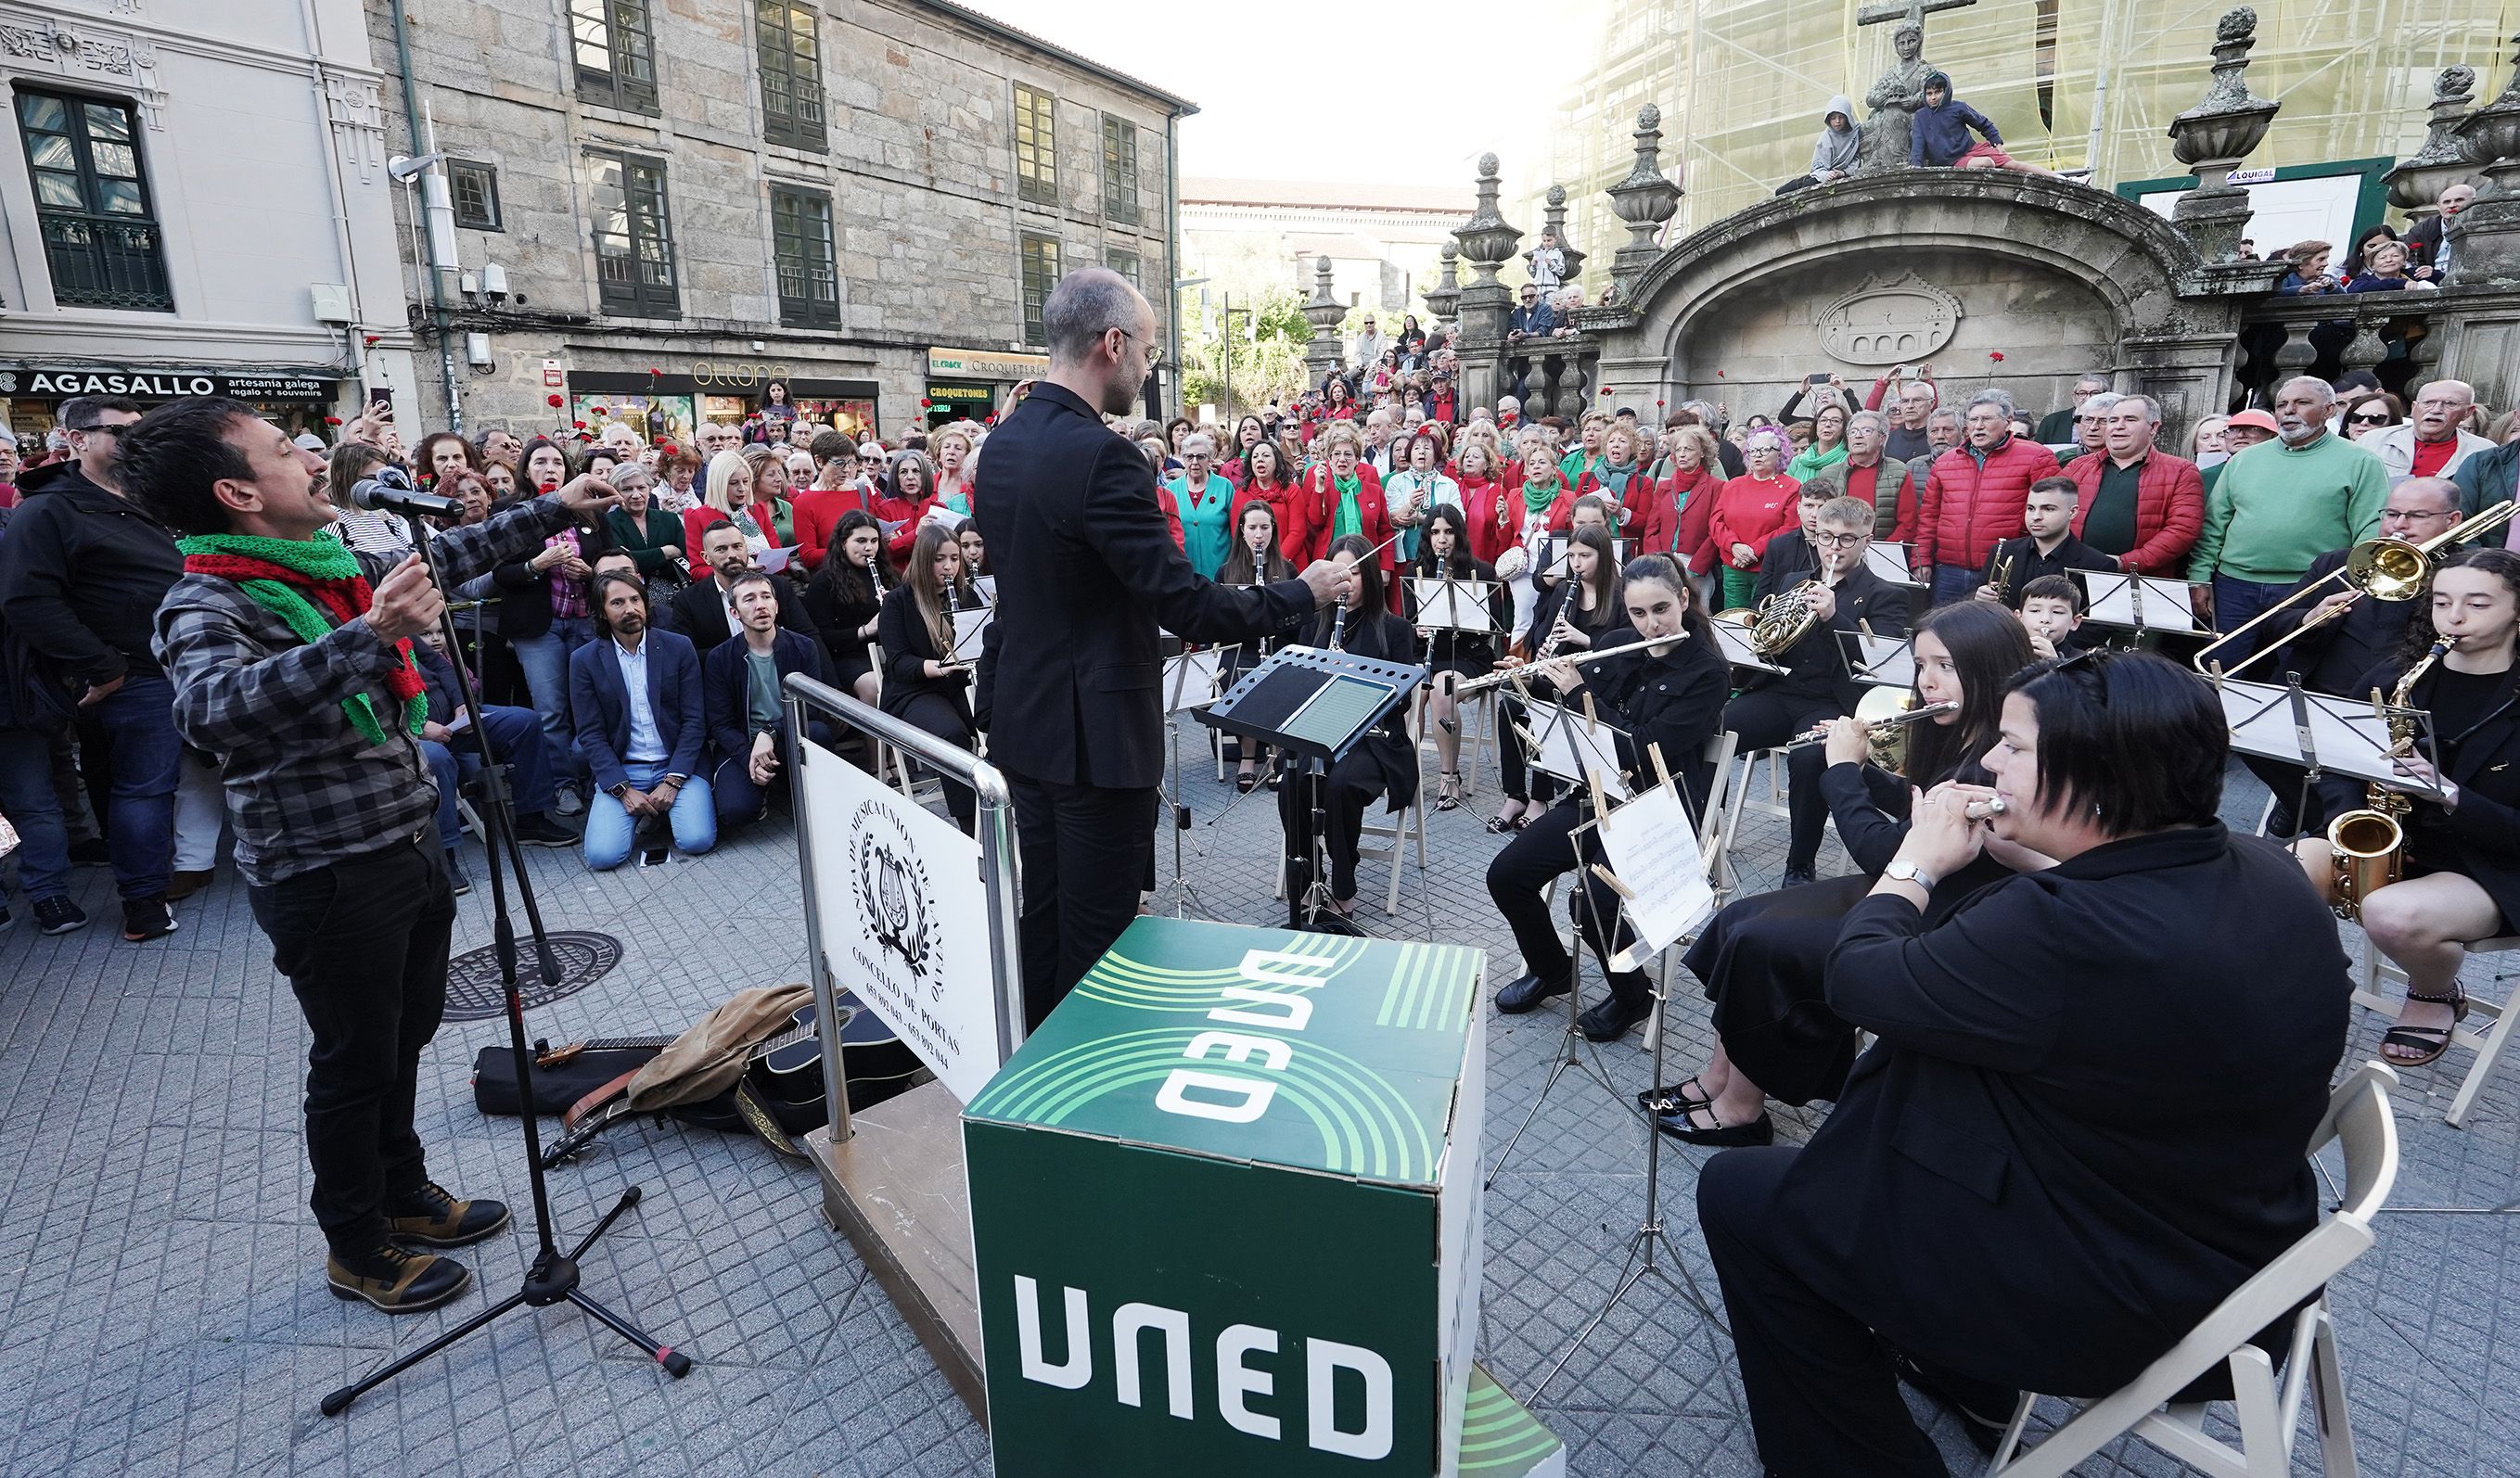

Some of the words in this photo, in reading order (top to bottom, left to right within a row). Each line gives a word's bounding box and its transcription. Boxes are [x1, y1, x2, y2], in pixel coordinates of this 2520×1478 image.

[30, 374, 214, 396] AGASALLO
[230, 389, 261, 397] regalo
[285, 379, 320, 389] galega
[930, 388, 988, 399] CROQUETONES
[882, 802, 916, 855] UNION
[852, 947, 901, 999] CONCELLO
[903, 992, 917, 1015] DE
[921, 1008, 960, 1056] PORTAS
[865, 983, 877, 1000] 653
[878, 993, 889, 1012] 892
[890, 1005, 902, 1024] 043
[907, 1022, 920, 1039] 653
[921, 1035, 934, 1055] 892
[935, 1048, 949, 1069] 044
[1156, 949, 1337, 1124] UNED
[1015, 1275, 1393, 1459] UNED
